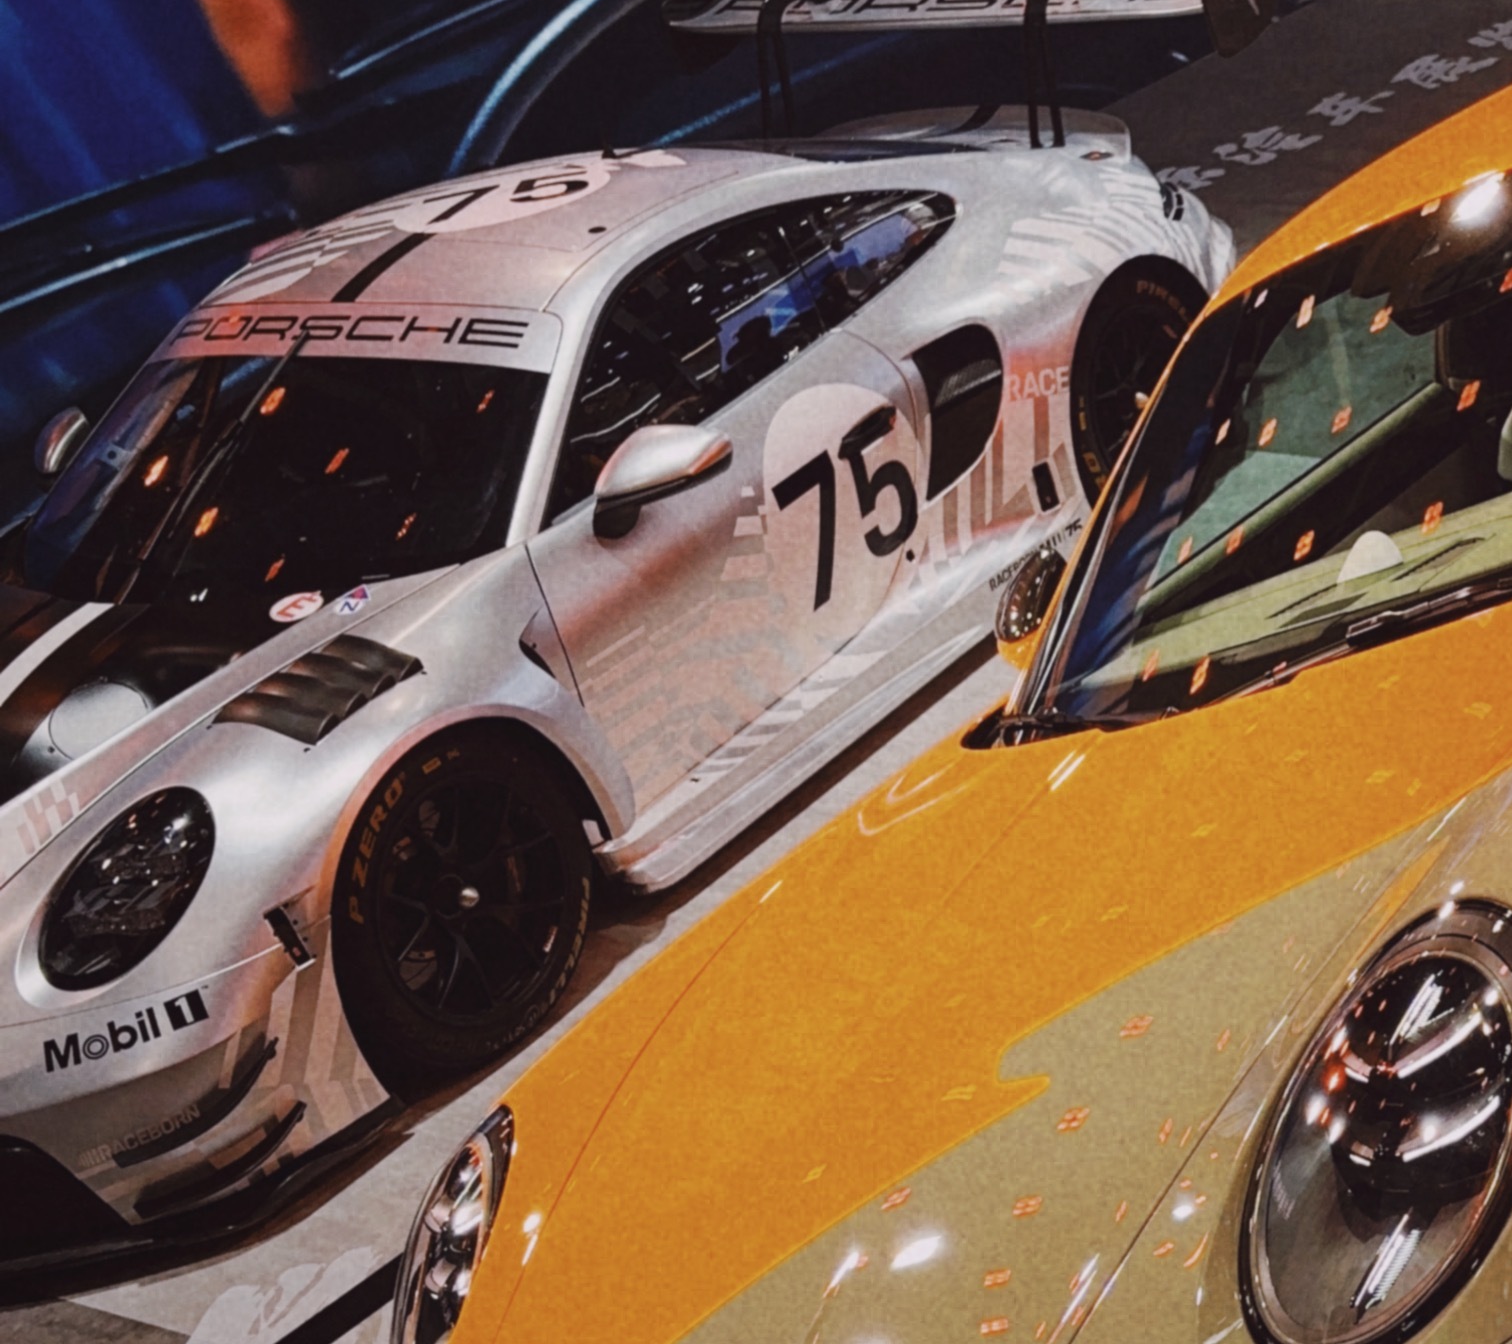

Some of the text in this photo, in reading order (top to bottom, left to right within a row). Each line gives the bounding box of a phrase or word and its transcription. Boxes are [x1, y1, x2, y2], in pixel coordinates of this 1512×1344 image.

[423, 169, 590, 225] 75
[169, 315, 530, 349] PORSCHE
[772, 405, 919, 613] 75
[352, 778, 404, 888] ZERO
[43, 1007, 162, 1073] Mobil
[99, 1105, 201, 1161] RACEBORN
